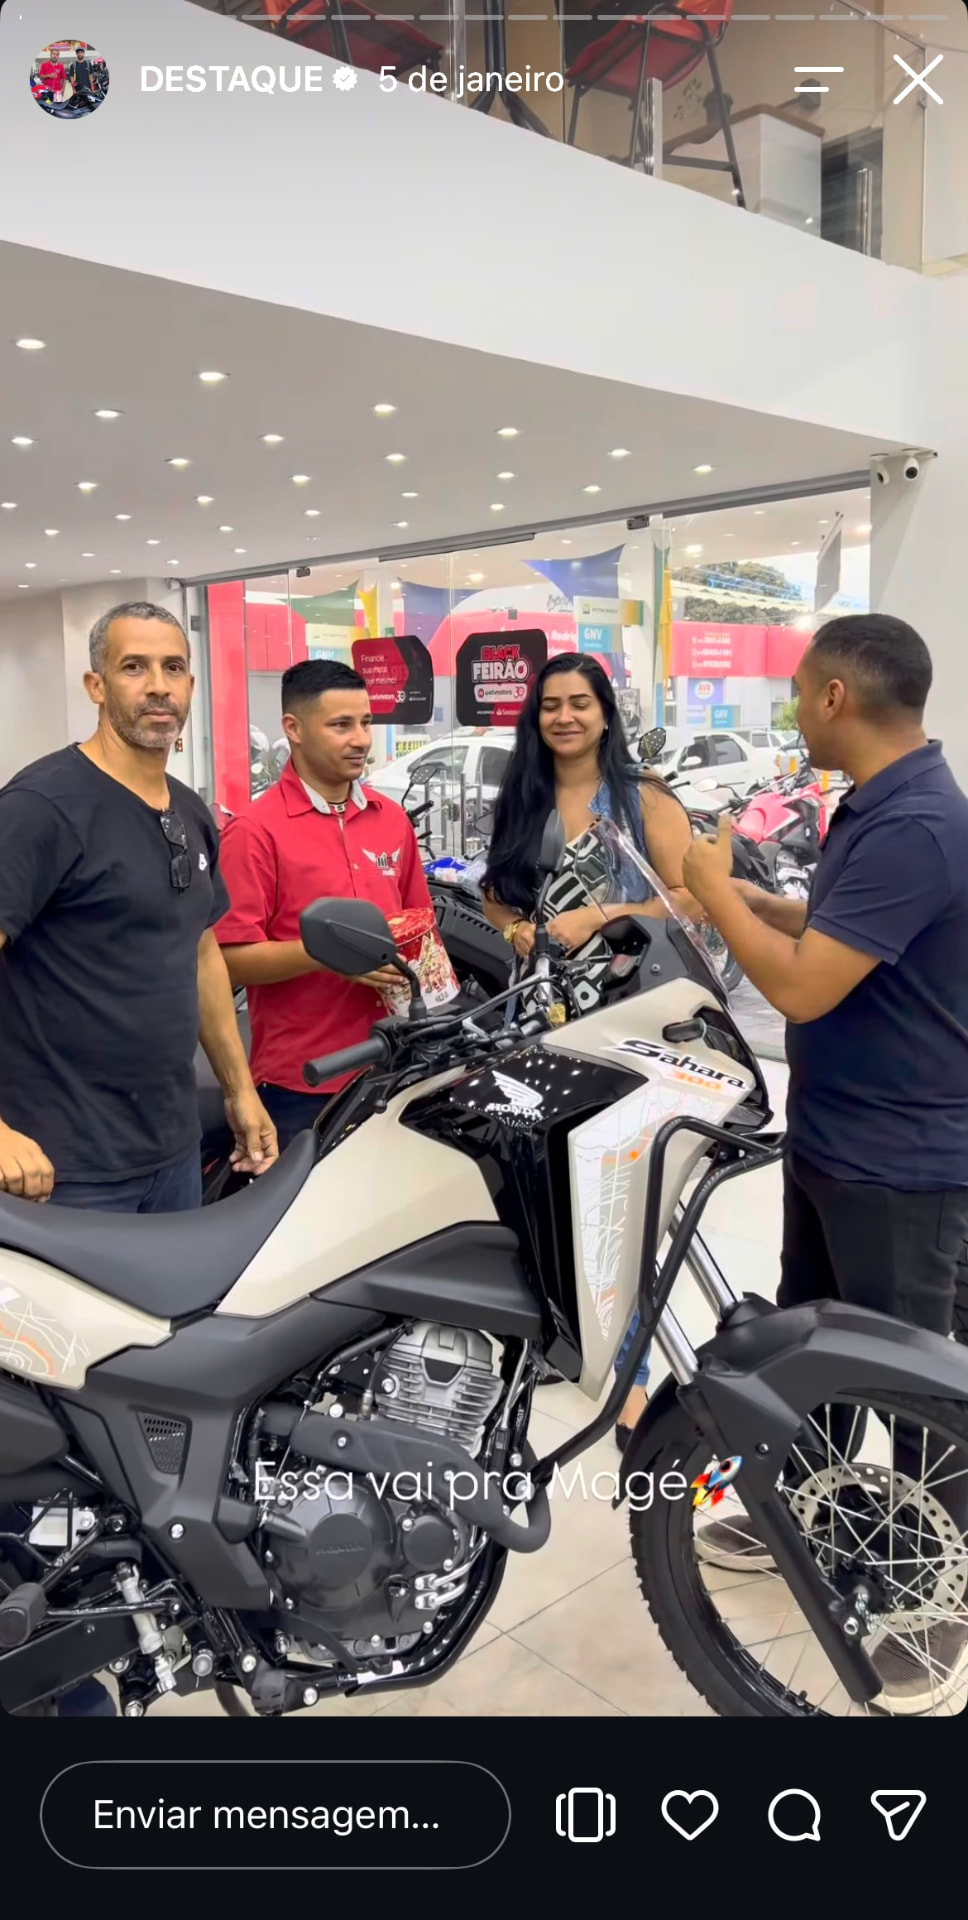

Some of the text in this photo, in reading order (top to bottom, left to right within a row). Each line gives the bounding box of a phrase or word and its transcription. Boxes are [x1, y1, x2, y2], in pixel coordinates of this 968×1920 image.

[584, 627, 603, 641] GNV
[482, 645, 519, 661] BLACK
[372, 665, 388, 674] moto
[473, 658, 528, 681] FEIRÃO
[513, 686, 525, 699] 30
[613, 1039, 746, 1089] Sahara
[673, 1070, 722, 1090] 300
[484, 1102, 544, 1121] HONDA
